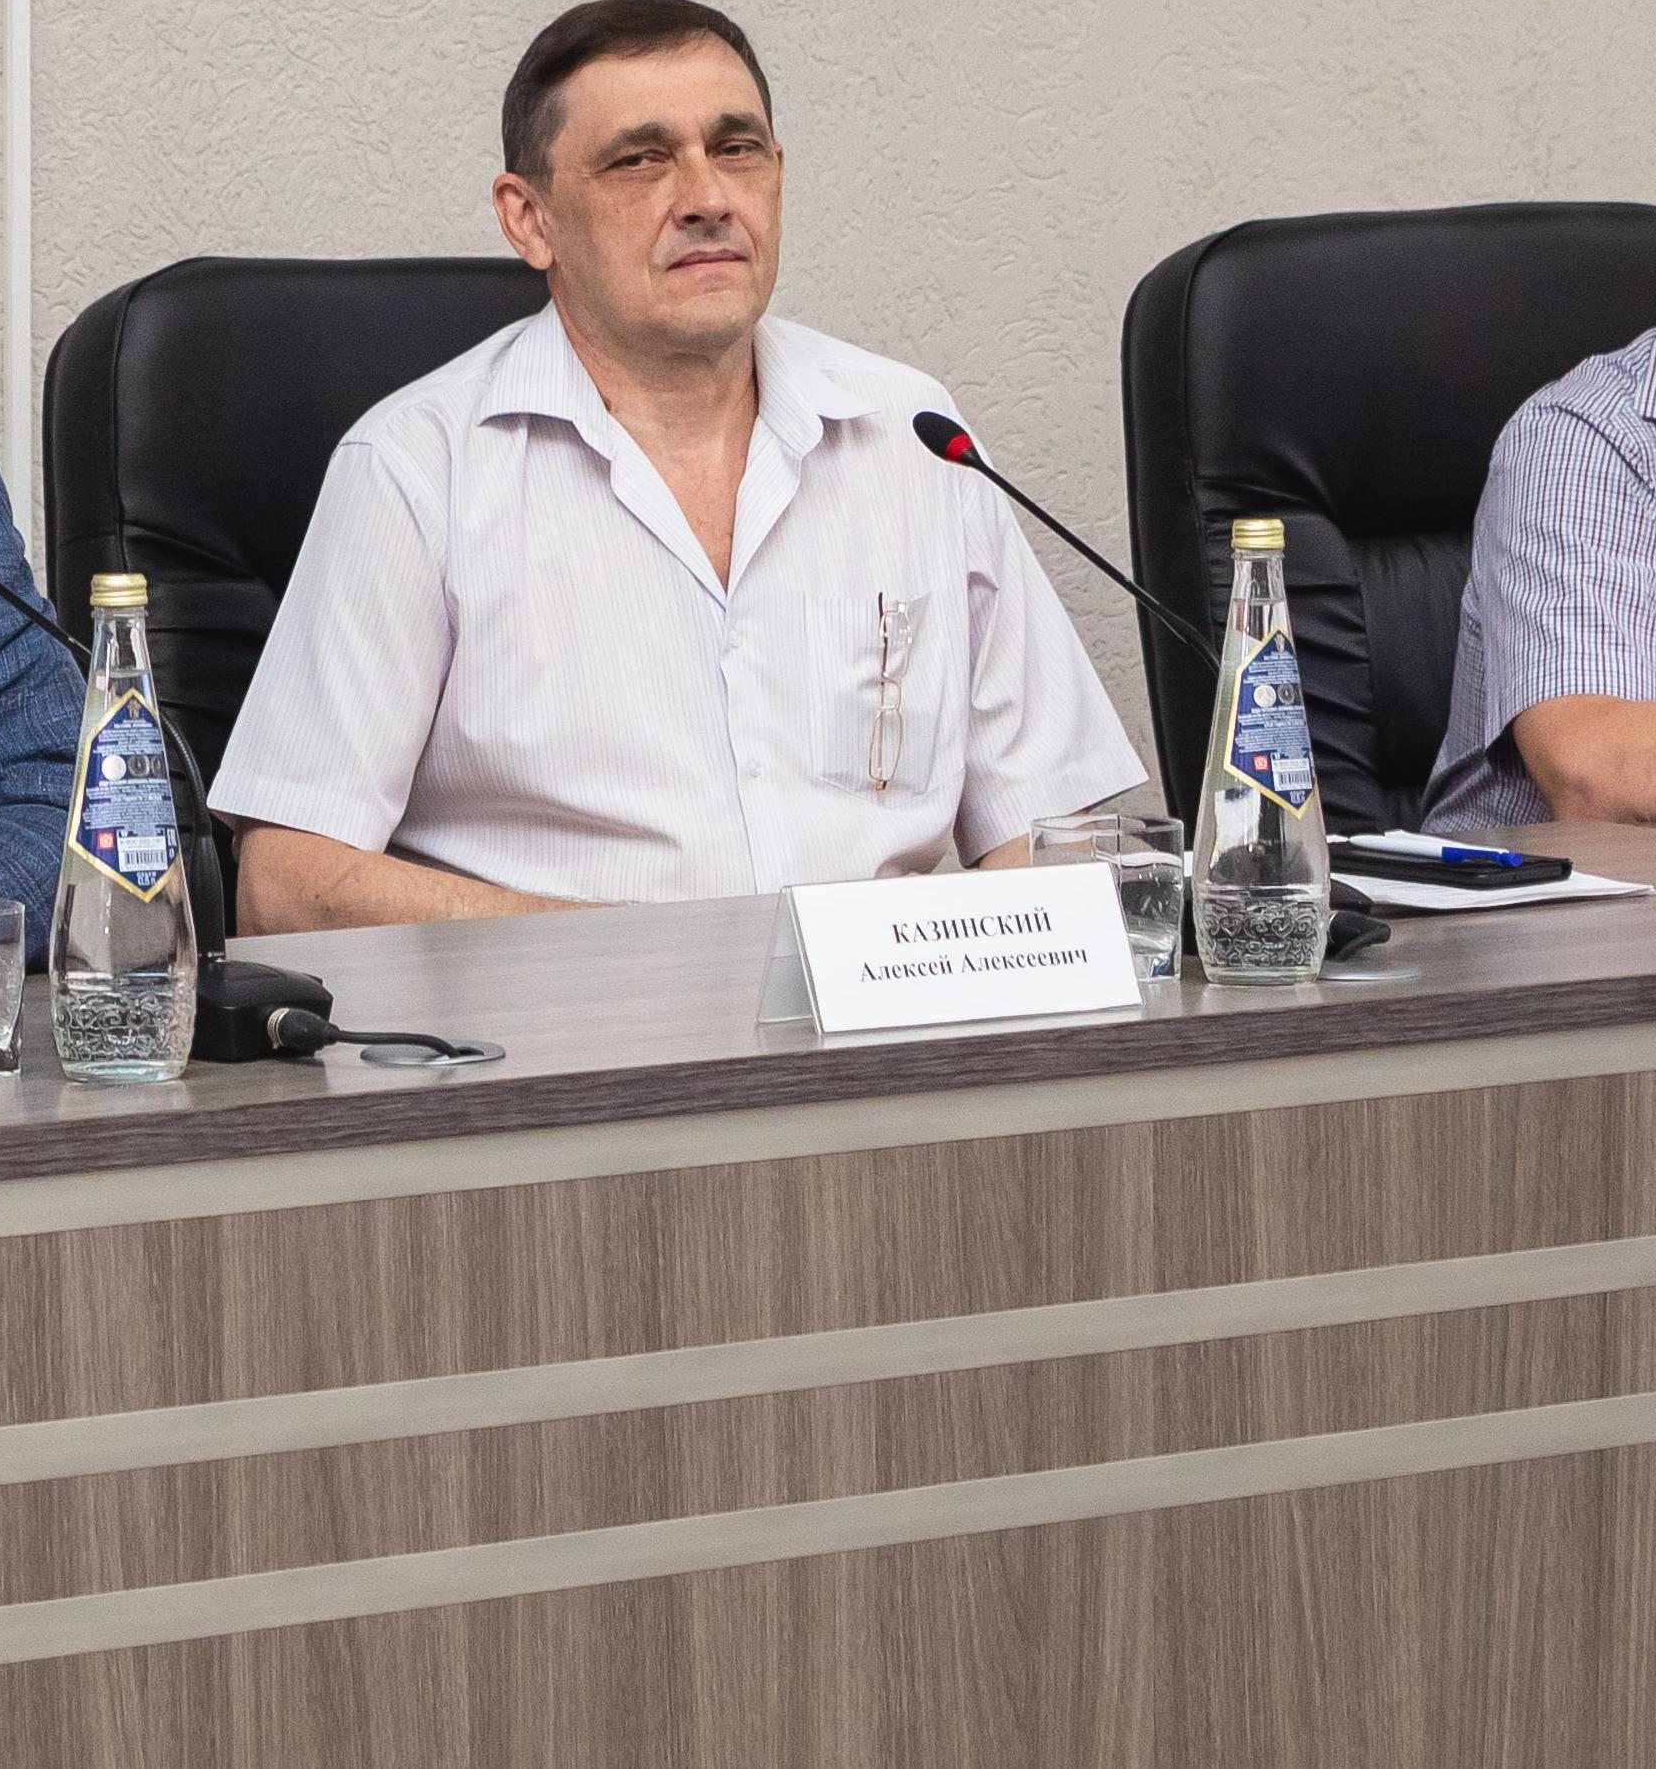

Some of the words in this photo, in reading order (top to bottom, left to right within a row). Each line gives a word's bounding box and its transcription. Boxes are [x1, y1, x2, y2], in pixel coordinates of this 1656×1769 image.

[892, 907, 1052, 944] КАЗИНСКИЙ
[860, 953, 953, 981] Алексей
[961, 949, 1088, 972] Алексеевич
